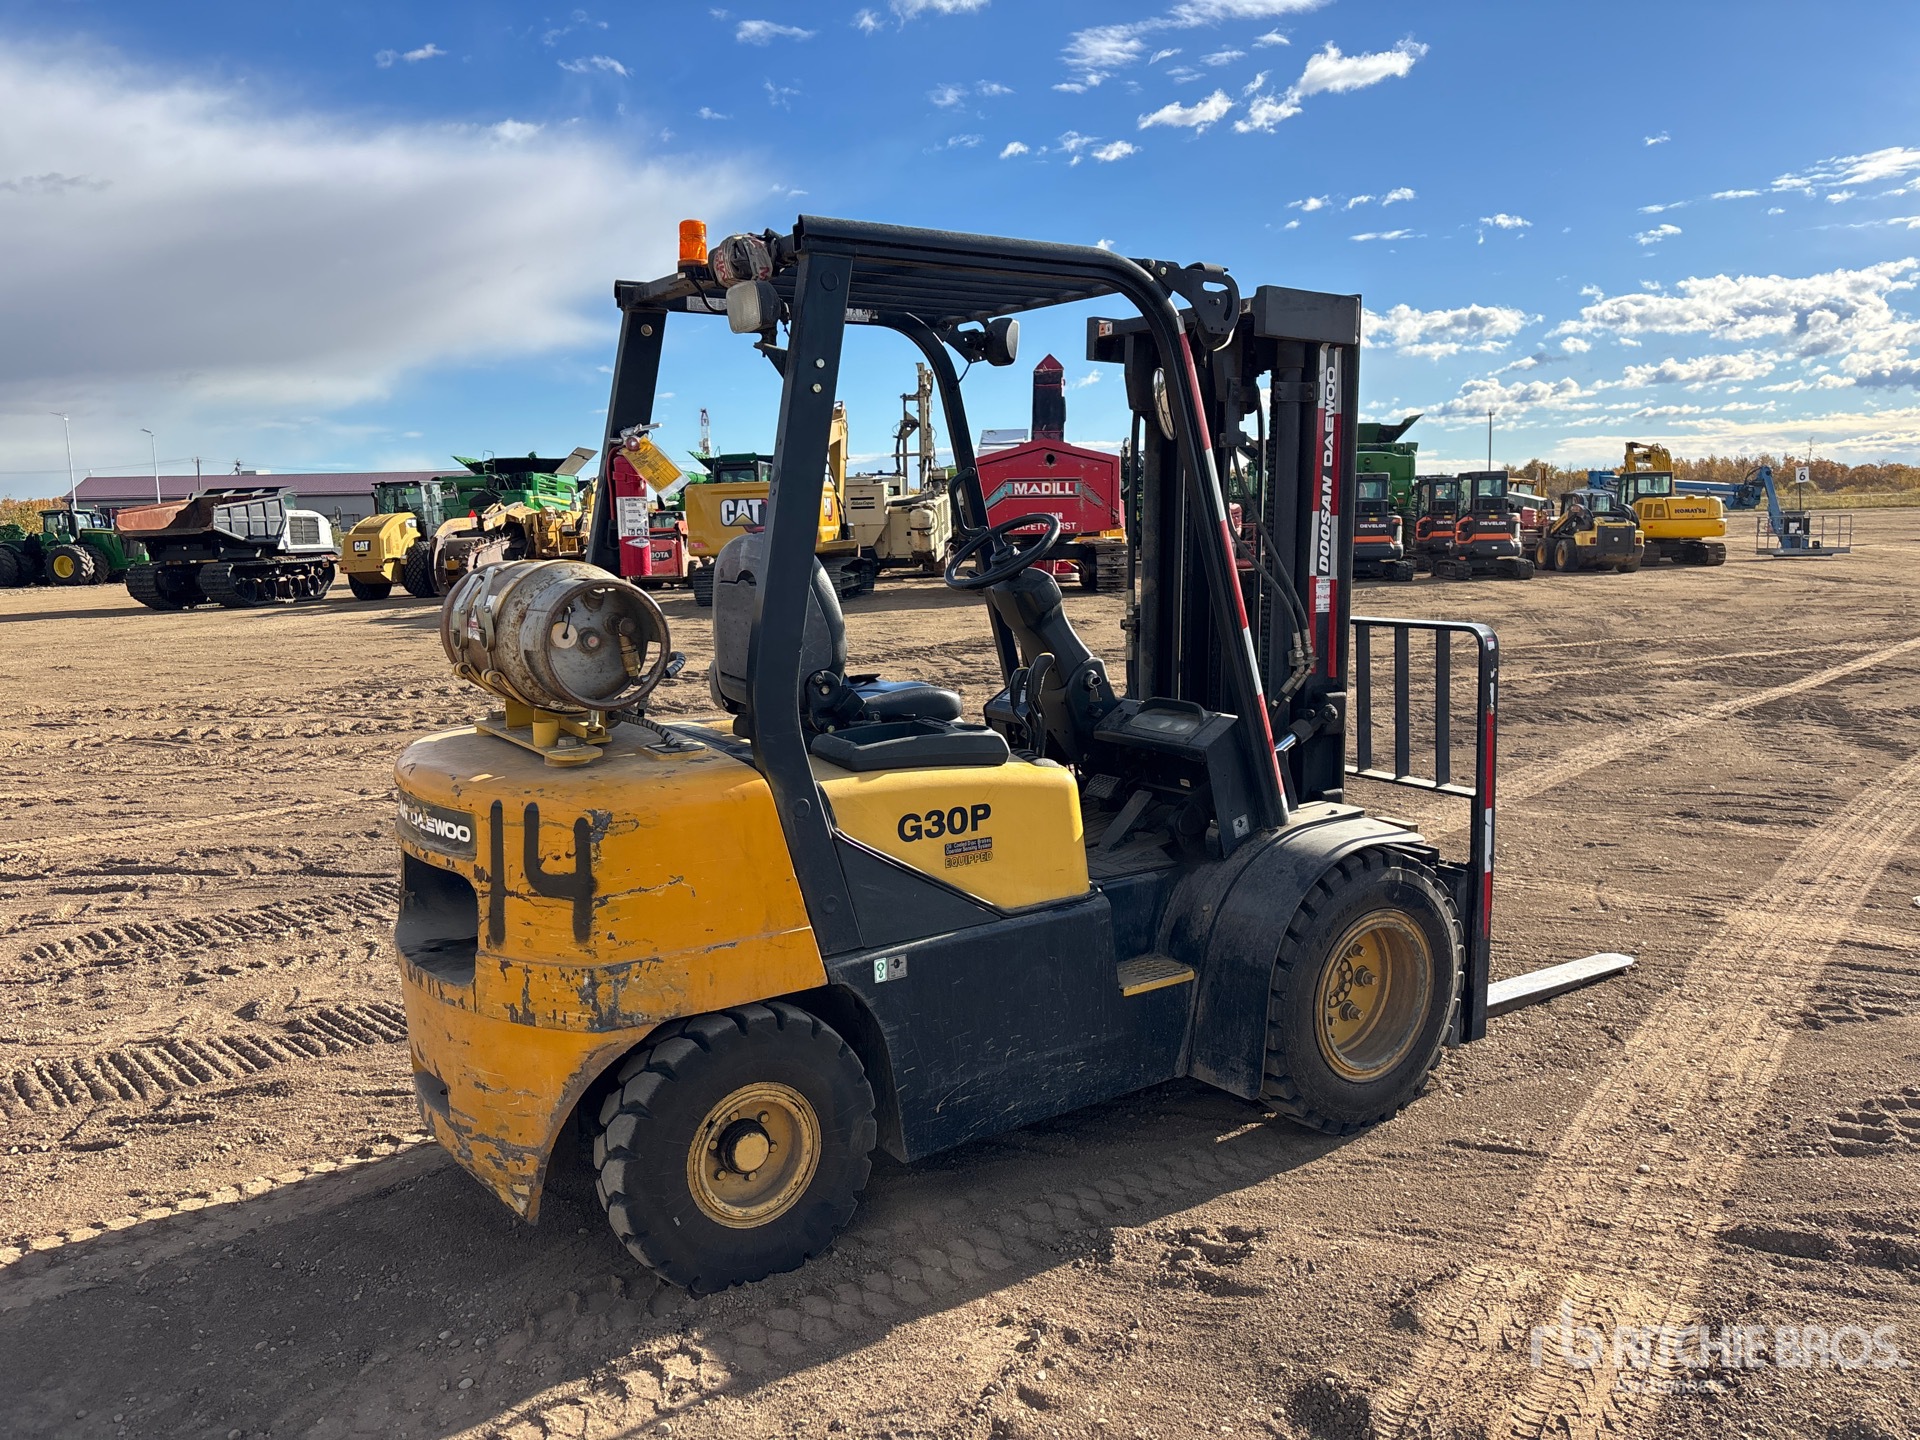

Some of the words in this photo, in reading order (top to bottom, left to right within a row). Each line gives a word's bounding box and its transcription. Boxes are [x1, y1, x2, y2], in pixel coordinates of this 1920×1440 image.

[1324, 365, 1336, 467] DAEWOO
[1014, 482, 1074, 495] MADILL
[1799, 471, 1806, 481] 6
[721, 499, 762, 525] CAT
[1318, 475, 1332, 574] DOOSAN
[354, 541, 369, 551] CAT
[410, 811, 471, 843] DAEWOO
[897, 803, 992, 842] G30P
[489, 799, 597, 946] 14
[945, 851, 993, 868] EQUIPPED
